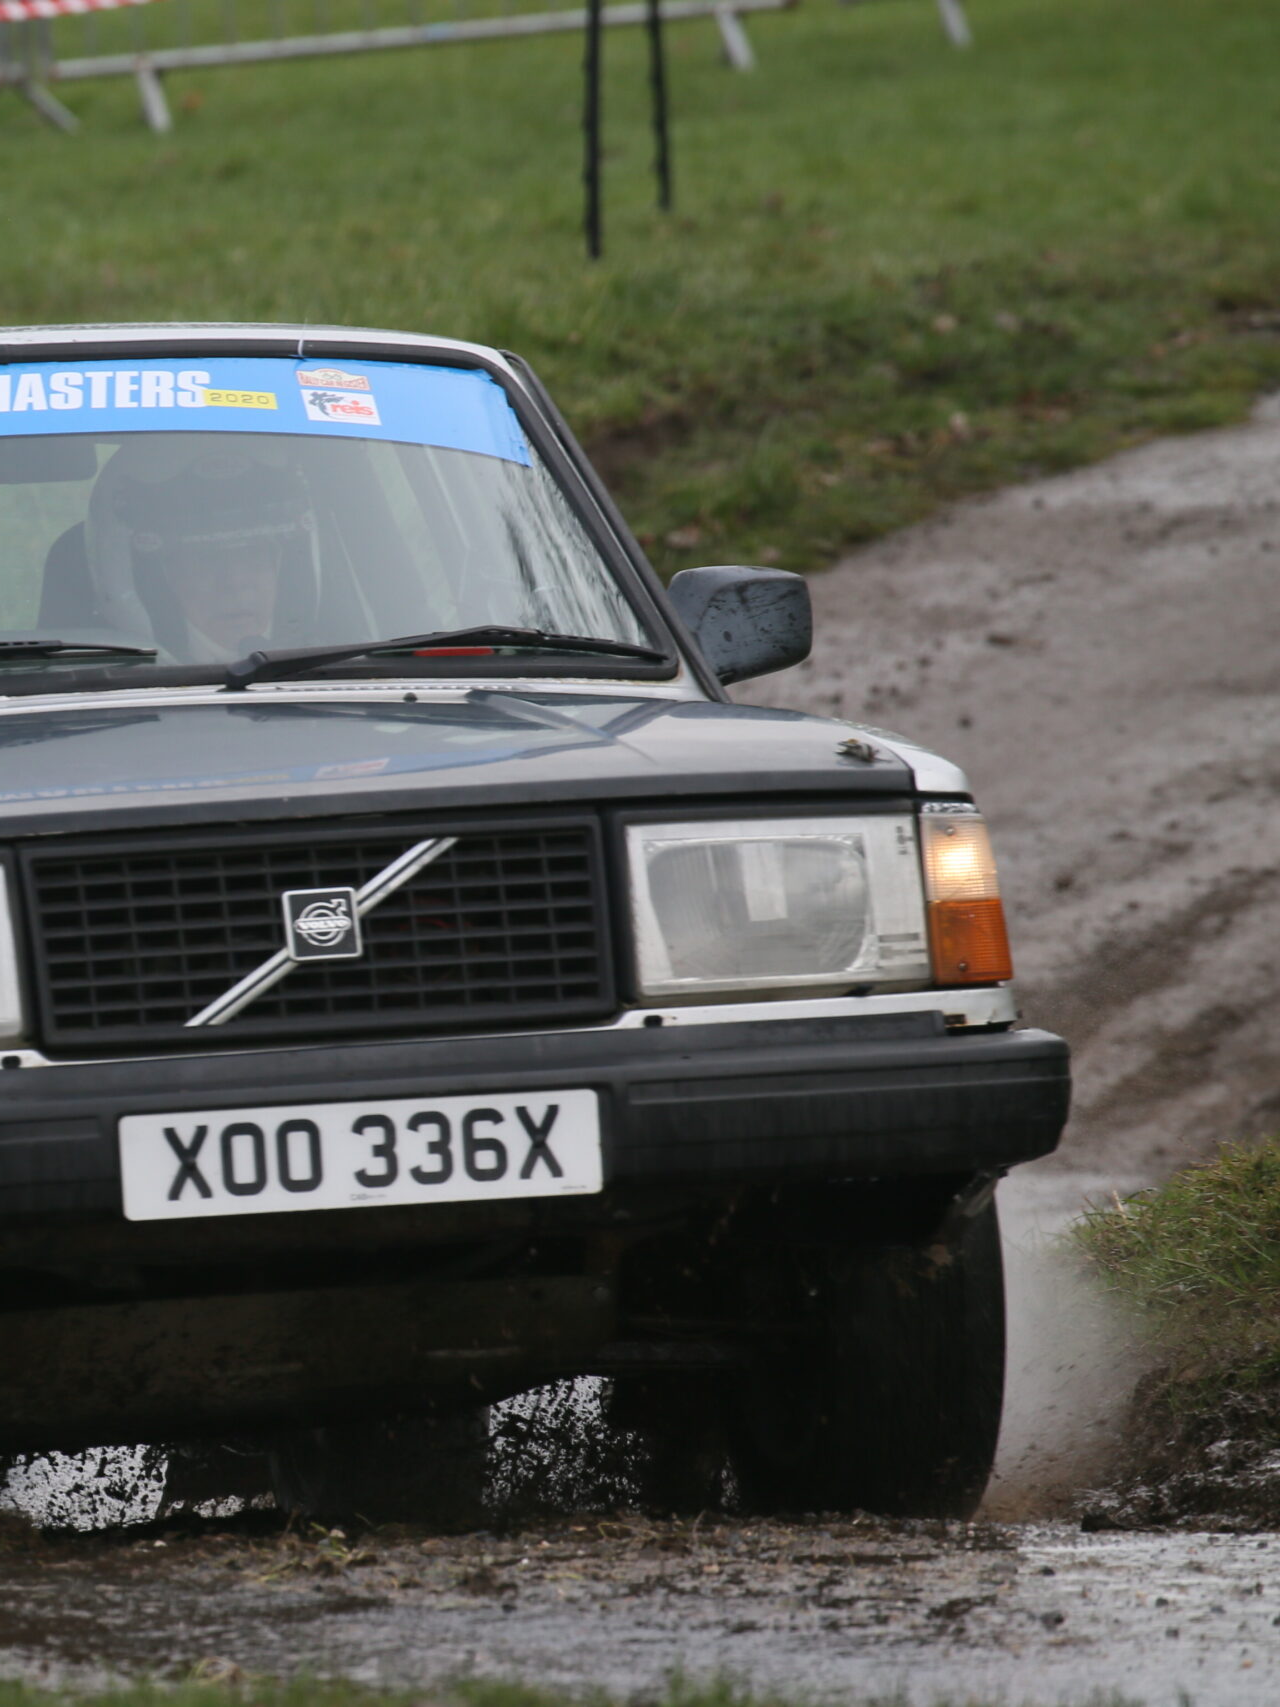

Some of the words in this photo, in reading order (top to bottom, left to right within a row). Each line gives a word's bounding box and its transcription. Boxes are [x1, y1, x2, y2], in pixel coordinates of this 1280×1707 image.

[209, 392, 270, 405] 2020
[330, 400, 374, 415] reis
[163, 1118, 323, 1200] XOO
[351, 1104, 564, 1188] 336X
